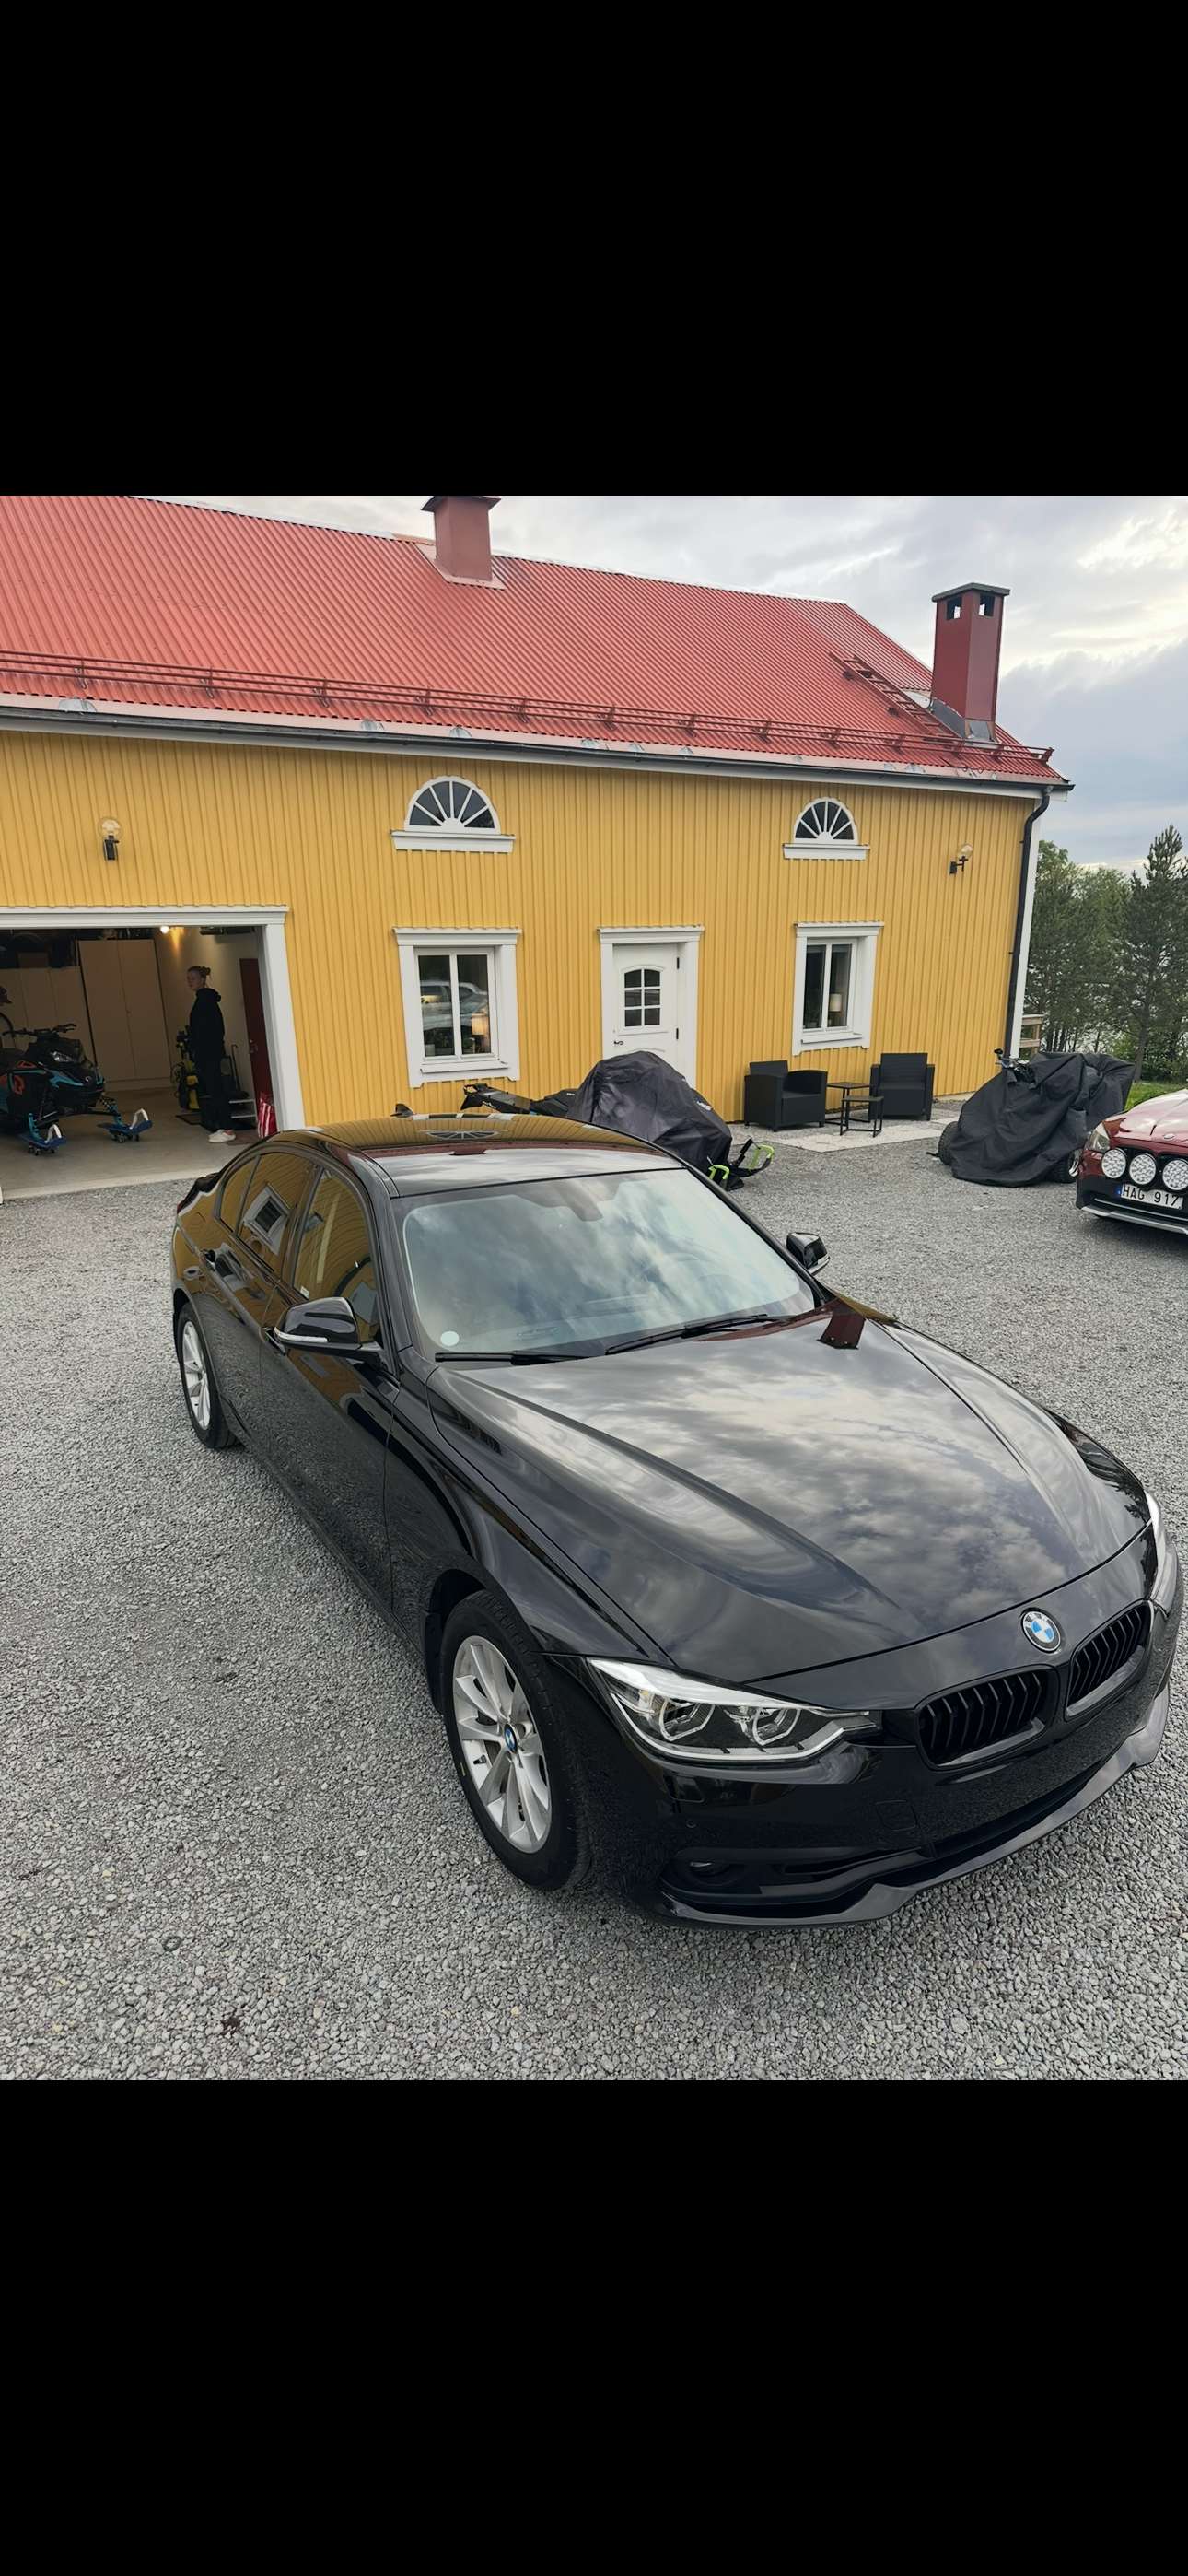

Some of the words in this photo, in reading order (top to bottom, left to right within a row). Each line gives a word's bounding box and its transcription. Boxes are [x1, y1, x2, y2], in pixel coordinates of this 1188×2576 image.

[1123, 1185, 1145, 1200] HAG
[1154, 1191, 1179, 1206] 917
[1024, 1611, 1049, 1629] BMW
